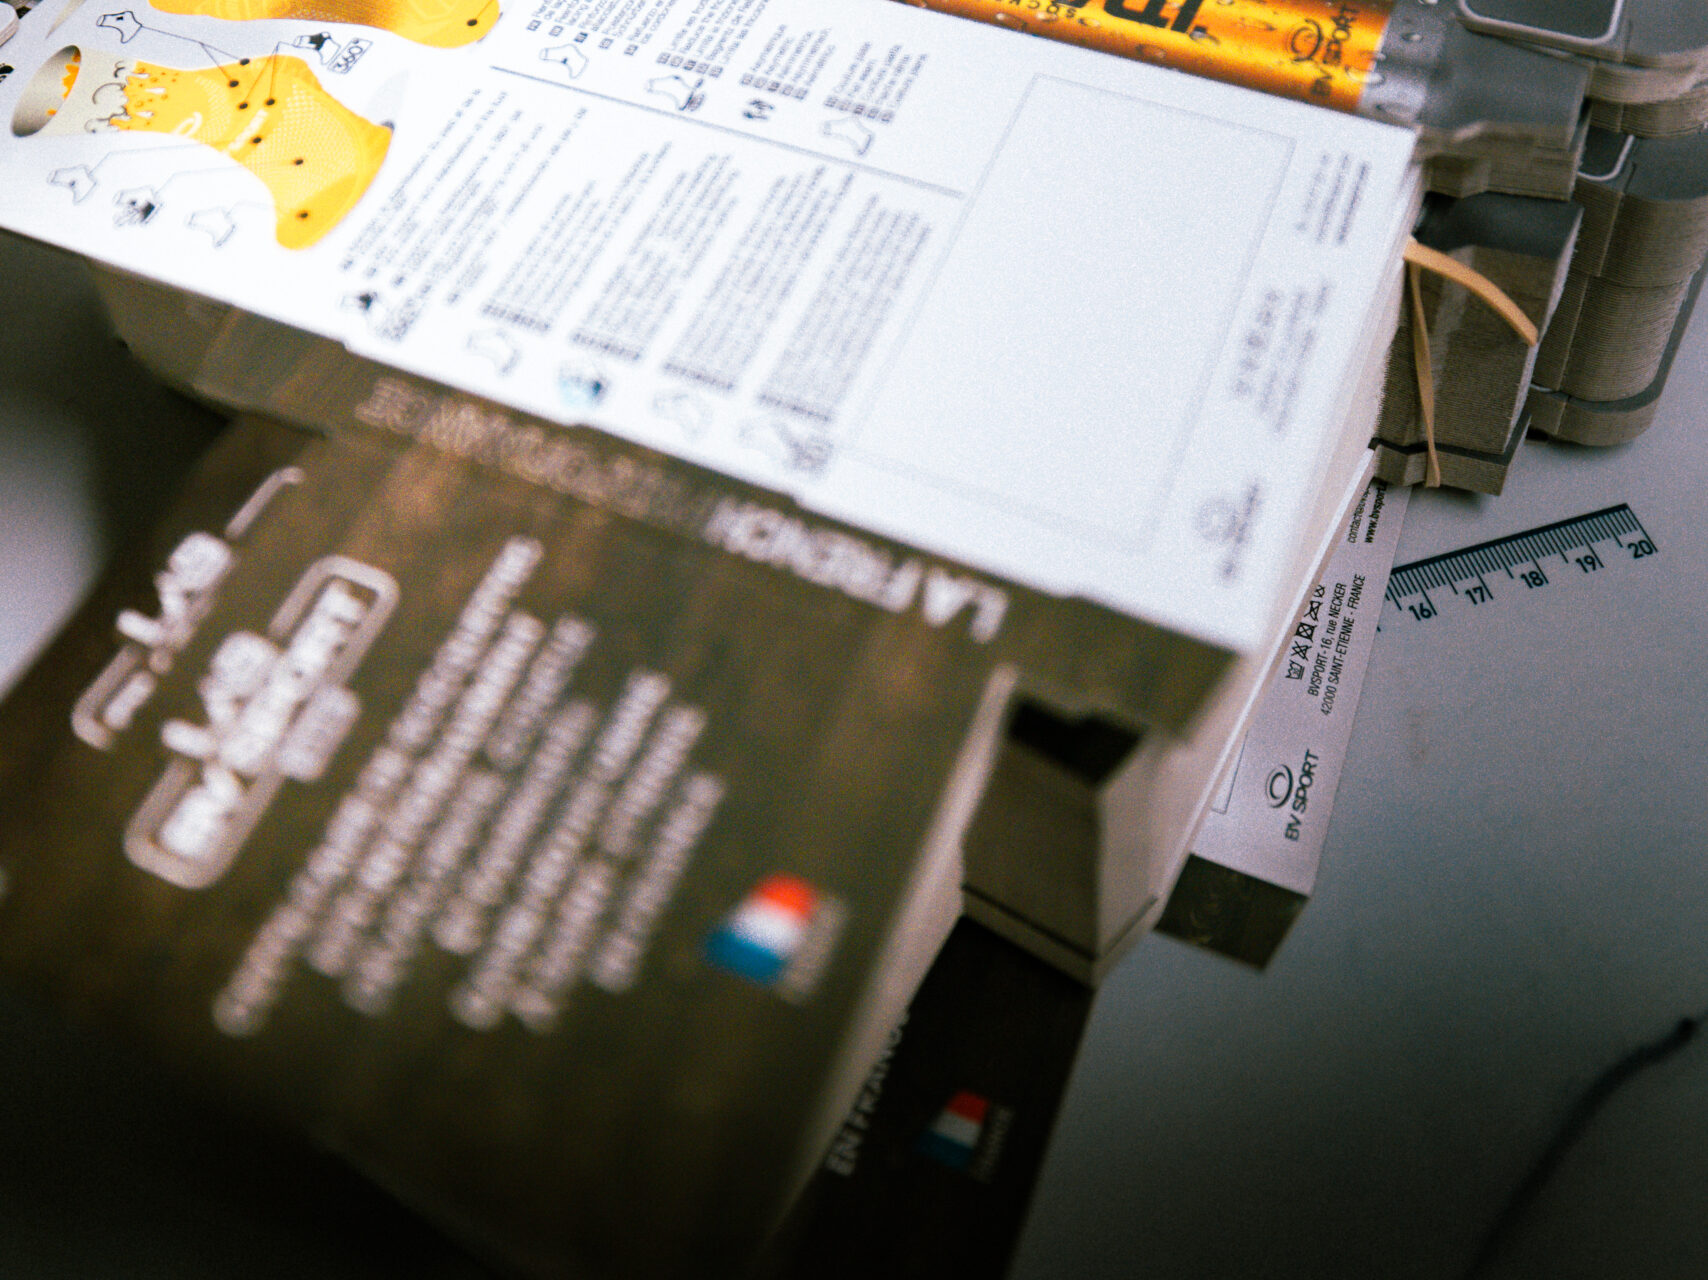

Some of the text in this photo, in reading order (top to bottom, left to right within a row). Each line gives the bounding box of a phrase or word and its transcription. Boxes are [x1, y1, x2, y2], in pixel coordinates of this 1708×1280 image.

[1329, 582, 1347, 619] NECKER
[1346, 573, 1367, 609] FRANCE
[1408, 539, 1655, 622] 16 17 18 19 20
[1328, 618, 1356, 687] SAINT-ETIENNE
[1321, 686, 1338, 717] 42000
[1284, 748, 1319, 842] BV SPORT
